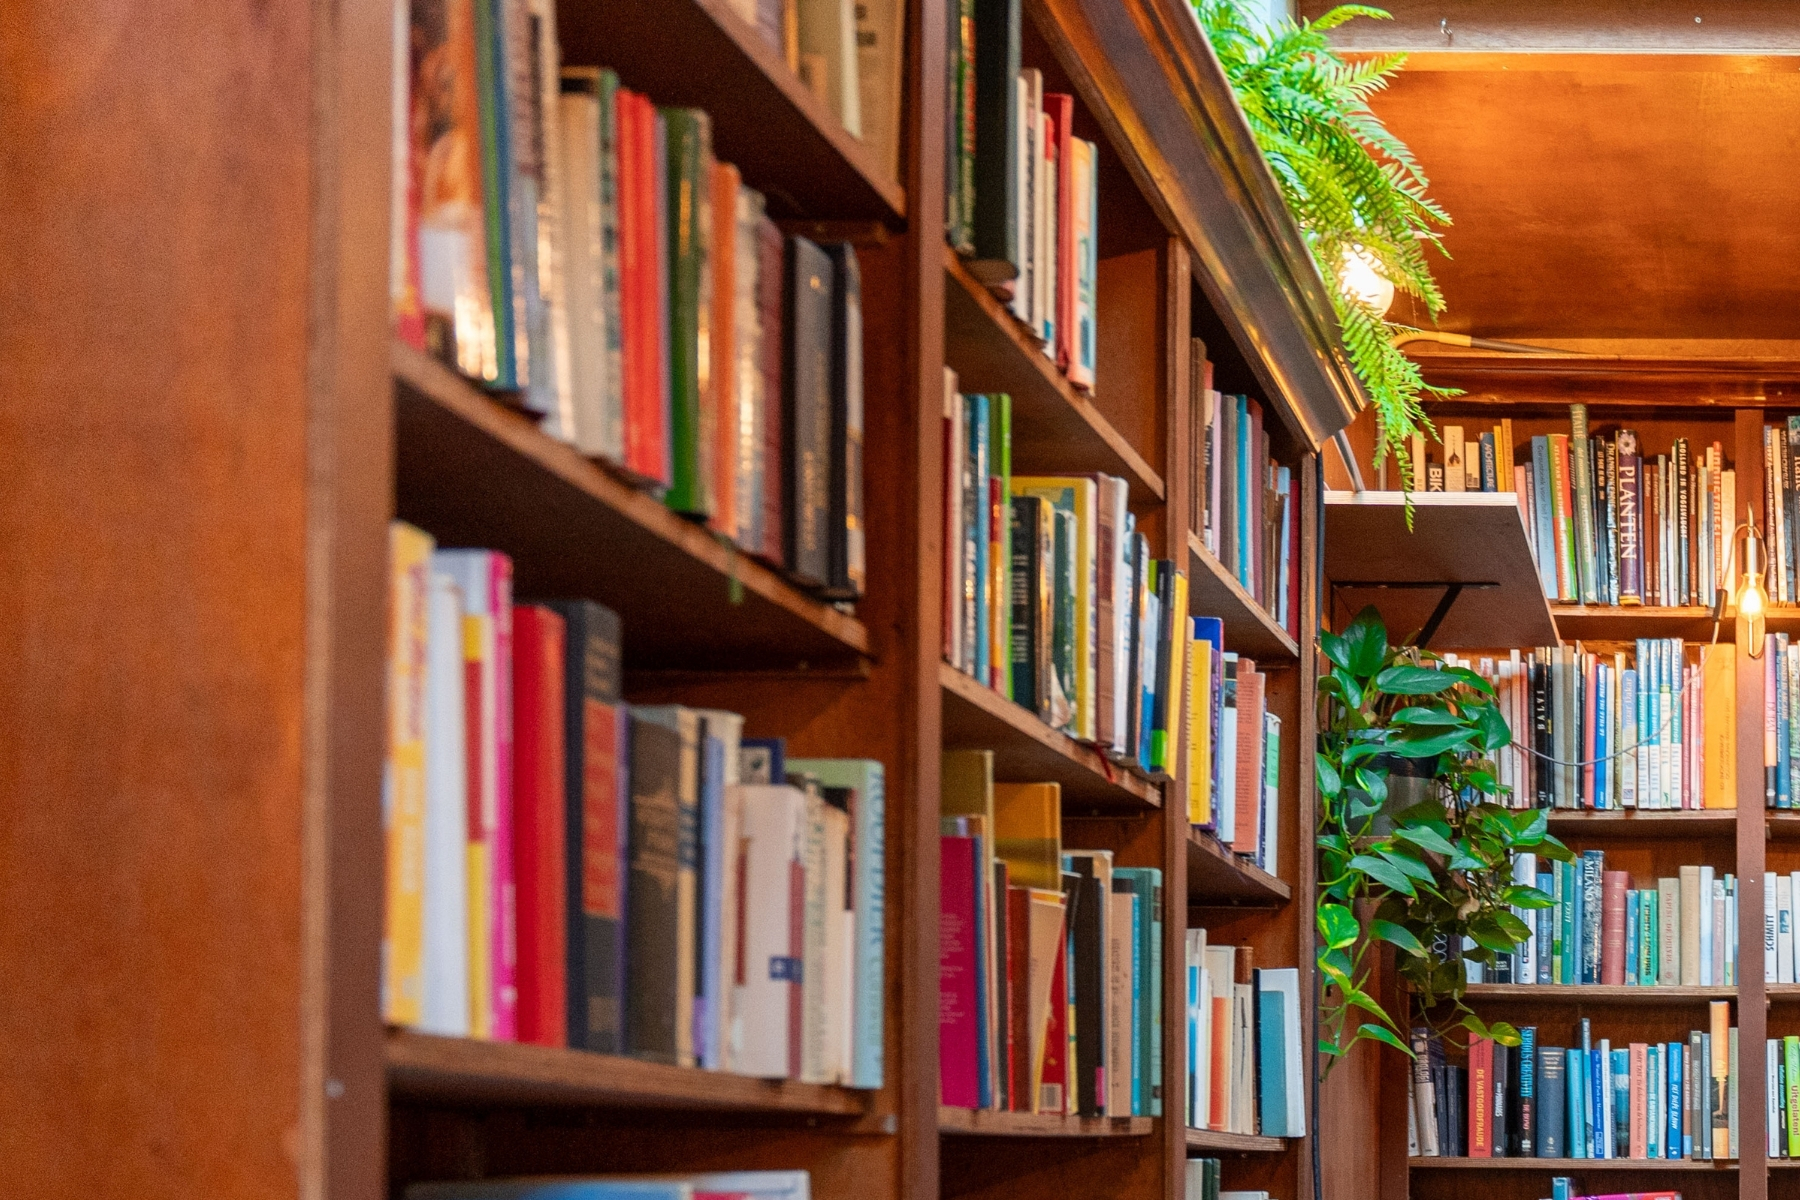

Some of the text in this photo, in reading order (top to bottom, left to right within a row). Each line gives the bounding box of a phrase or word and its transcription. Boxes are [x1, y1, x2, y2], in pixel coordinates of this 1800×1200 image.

[1483, 443, 1495, 488] ARCHITECTURE
[1619, 466, 1638, 559] PLANTEN
[1679, 444, 1689, 539] HOLLAND IN VOGELVLUCHT
[1583, 860, 1595, 901] MILANO
[1766, 914, 1774, 951] SCHMITT
[1520, 1029, 1534, 1058] SERIOUS
[1520, 1060, 1534, 1098] CREATIVITY
[1475, 1069, 1485, 1147] DE VASTGOEDFRAUDE
[1790, 1085, 1800, 1136] Uitgelaten!
